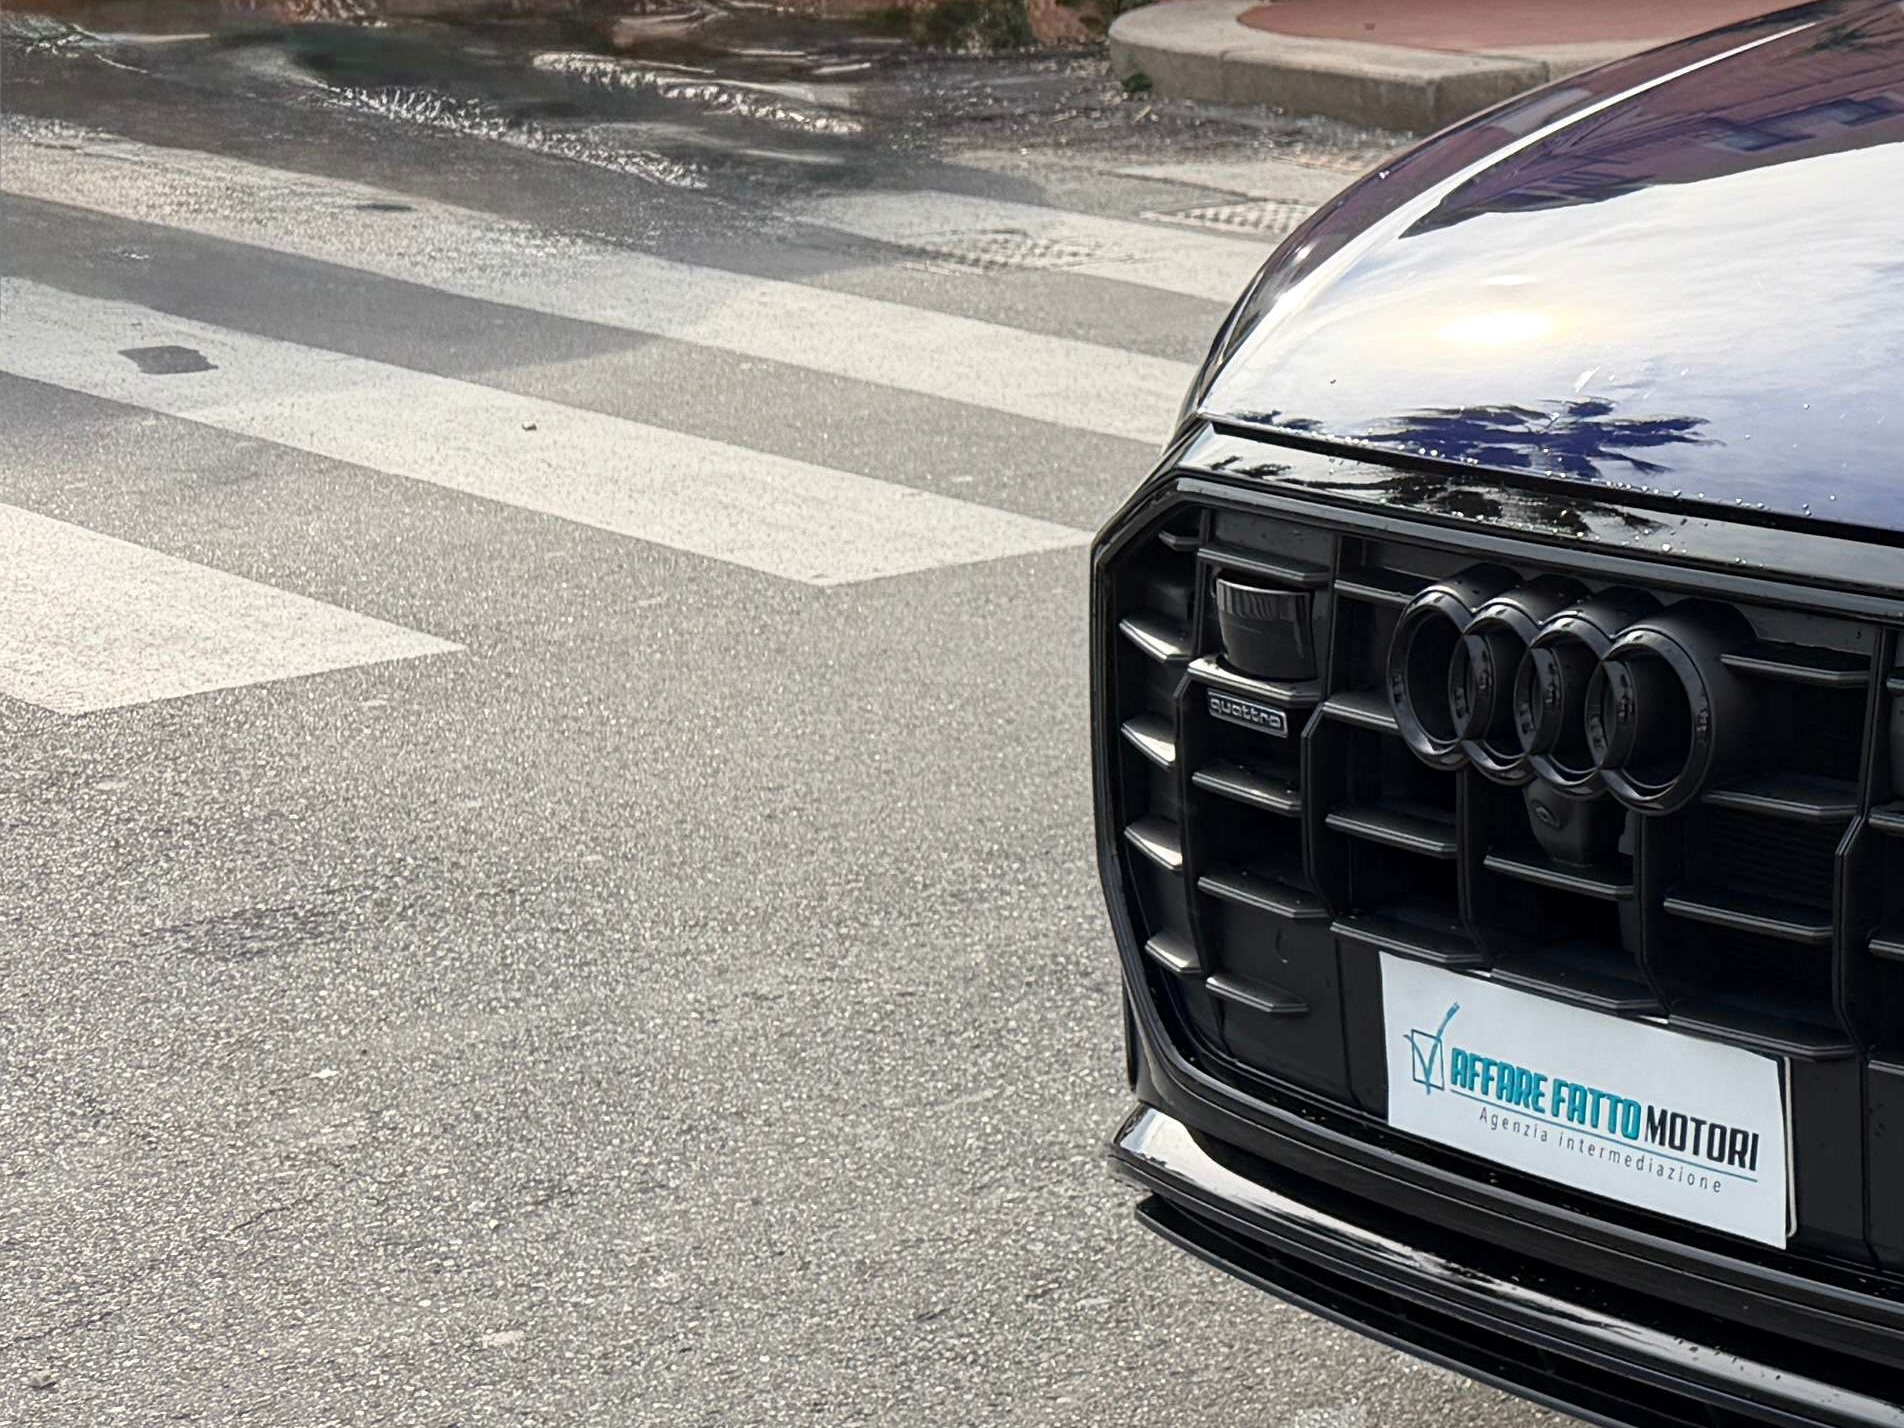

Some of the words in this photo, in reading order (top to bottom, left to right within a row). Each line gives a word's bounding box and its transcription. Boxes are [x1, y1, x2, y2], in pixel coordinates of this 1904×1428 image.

[1210, 698, 1281, 728] quattro
[1451, 1047, 1548, 1114] AFFARE
[1551, 1078, 1642, 1141] FATTO
[1644, 1105, 1760, 1172] MOTORI
[1479, 1106, 1548, 1143] Agenzia
[1558, 1132, 1722, 1193] intermediazione
